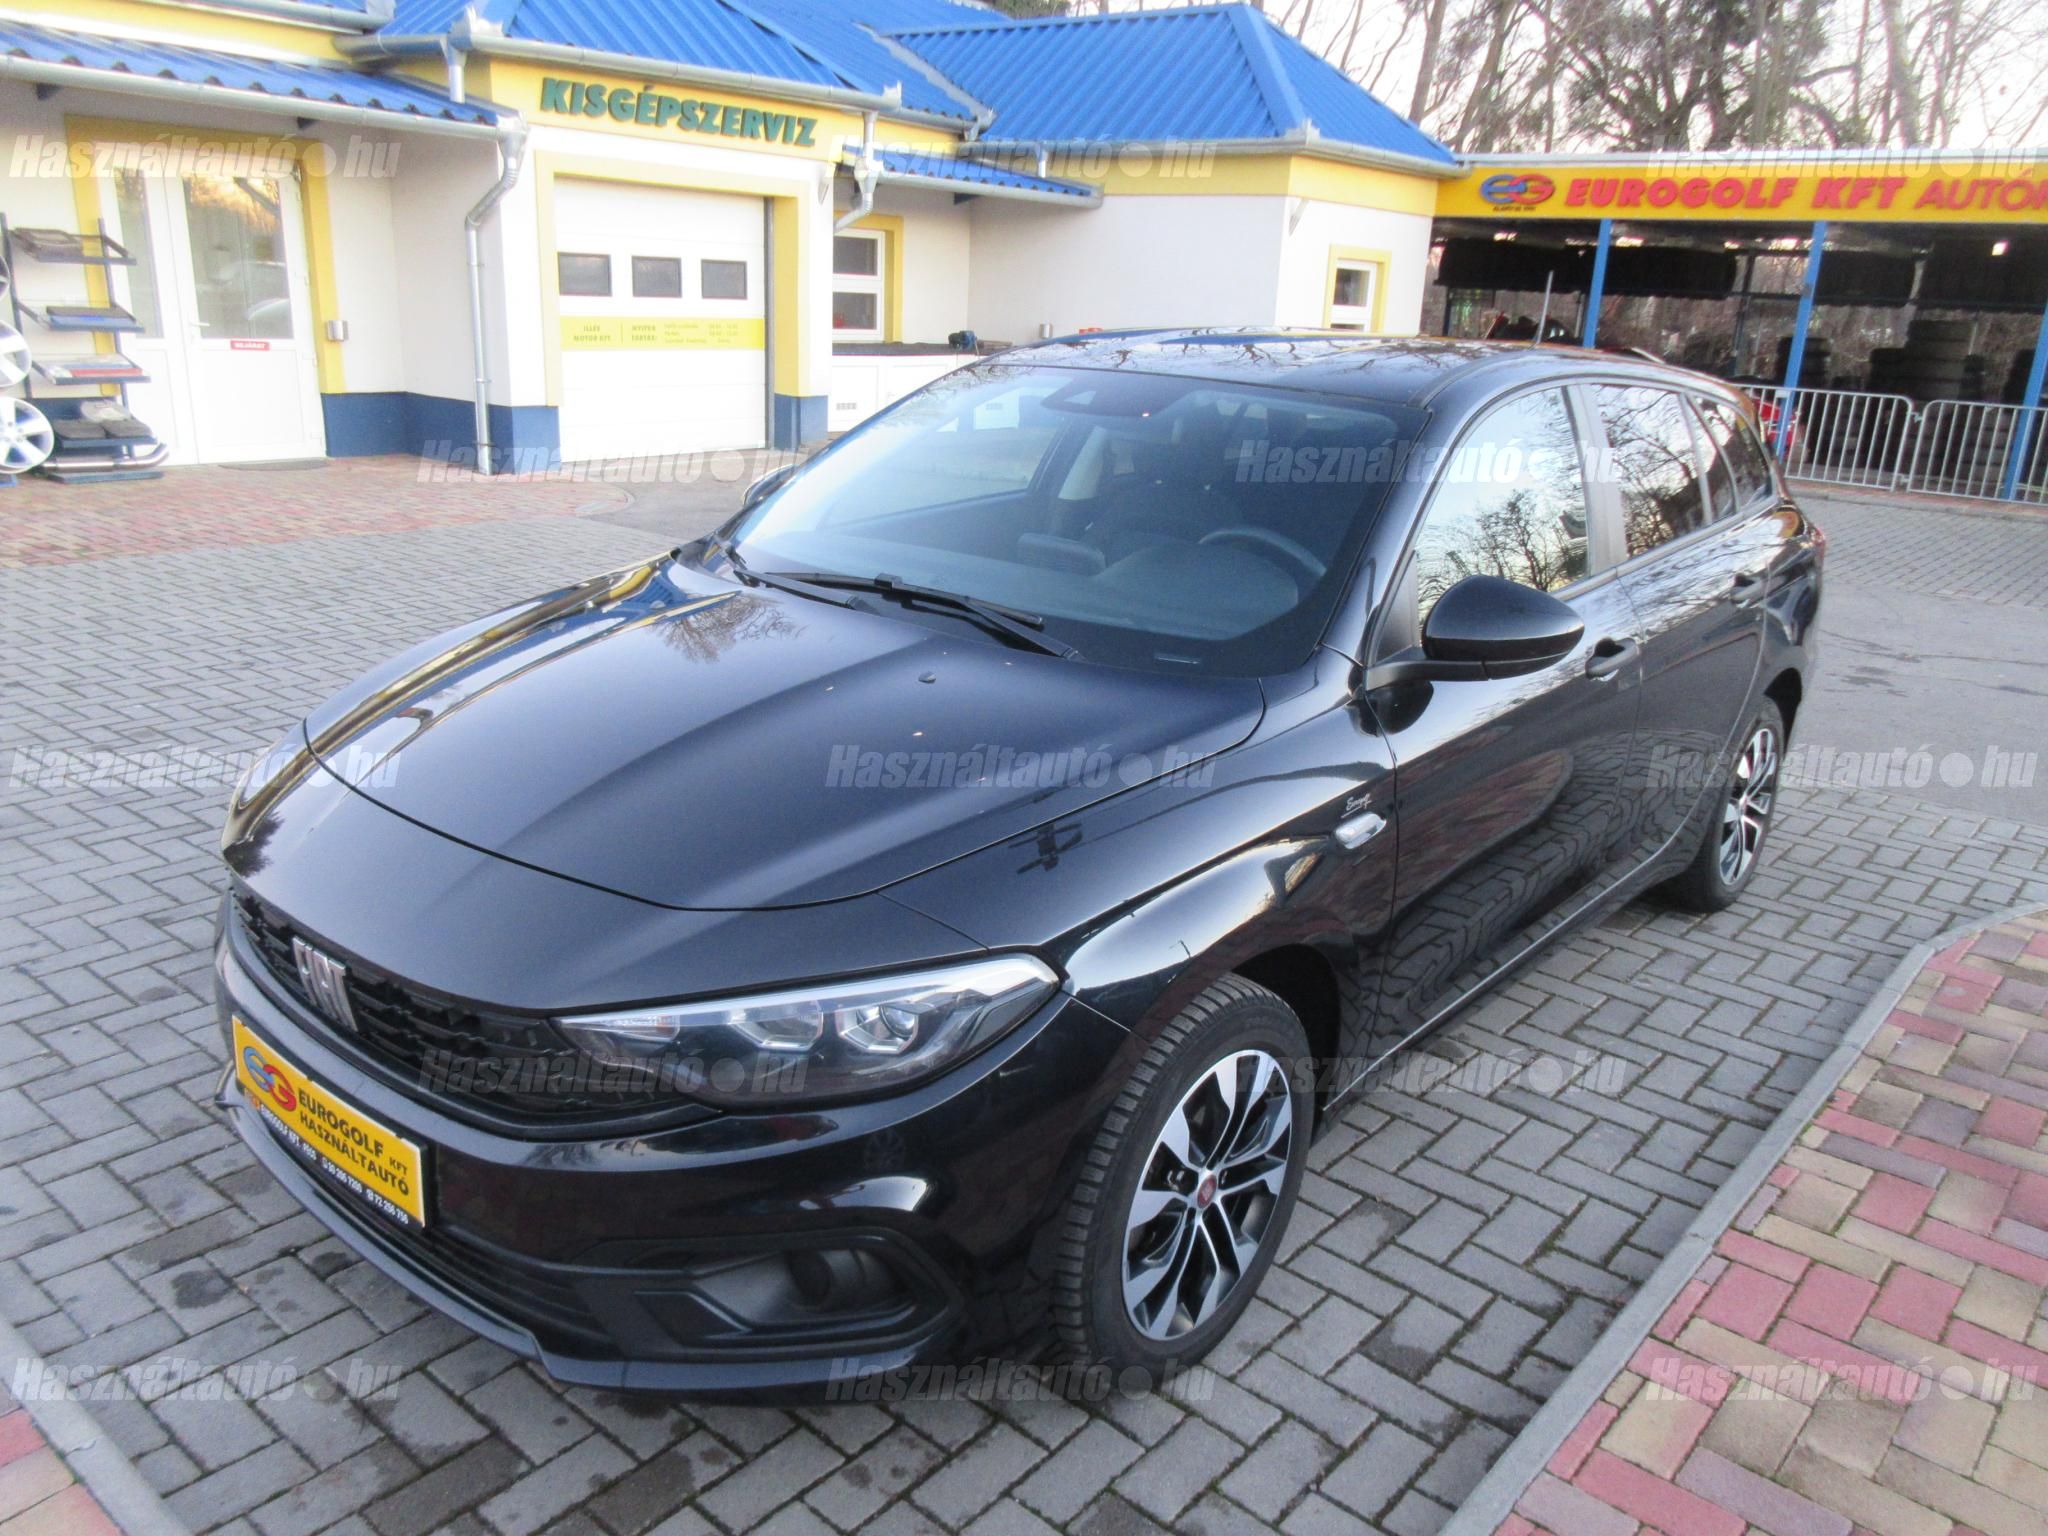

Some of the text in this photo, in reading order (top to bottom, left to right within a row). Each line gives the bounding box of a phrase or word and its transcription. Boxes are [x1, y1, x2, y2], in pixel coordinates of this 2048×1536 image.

[540, 77, 818, 147] KISGÉPSZERVIZ
[1564, 177, 1799, 209] EUROGOLF
[1811, 177, 1908, 209] KFT
[298, 1088, 384, 1158] EUROGOLF
[389, 1156, 408, 1175] KFT
[300, 1111, 409, 1195] HASZNÁLTAUTÓ
